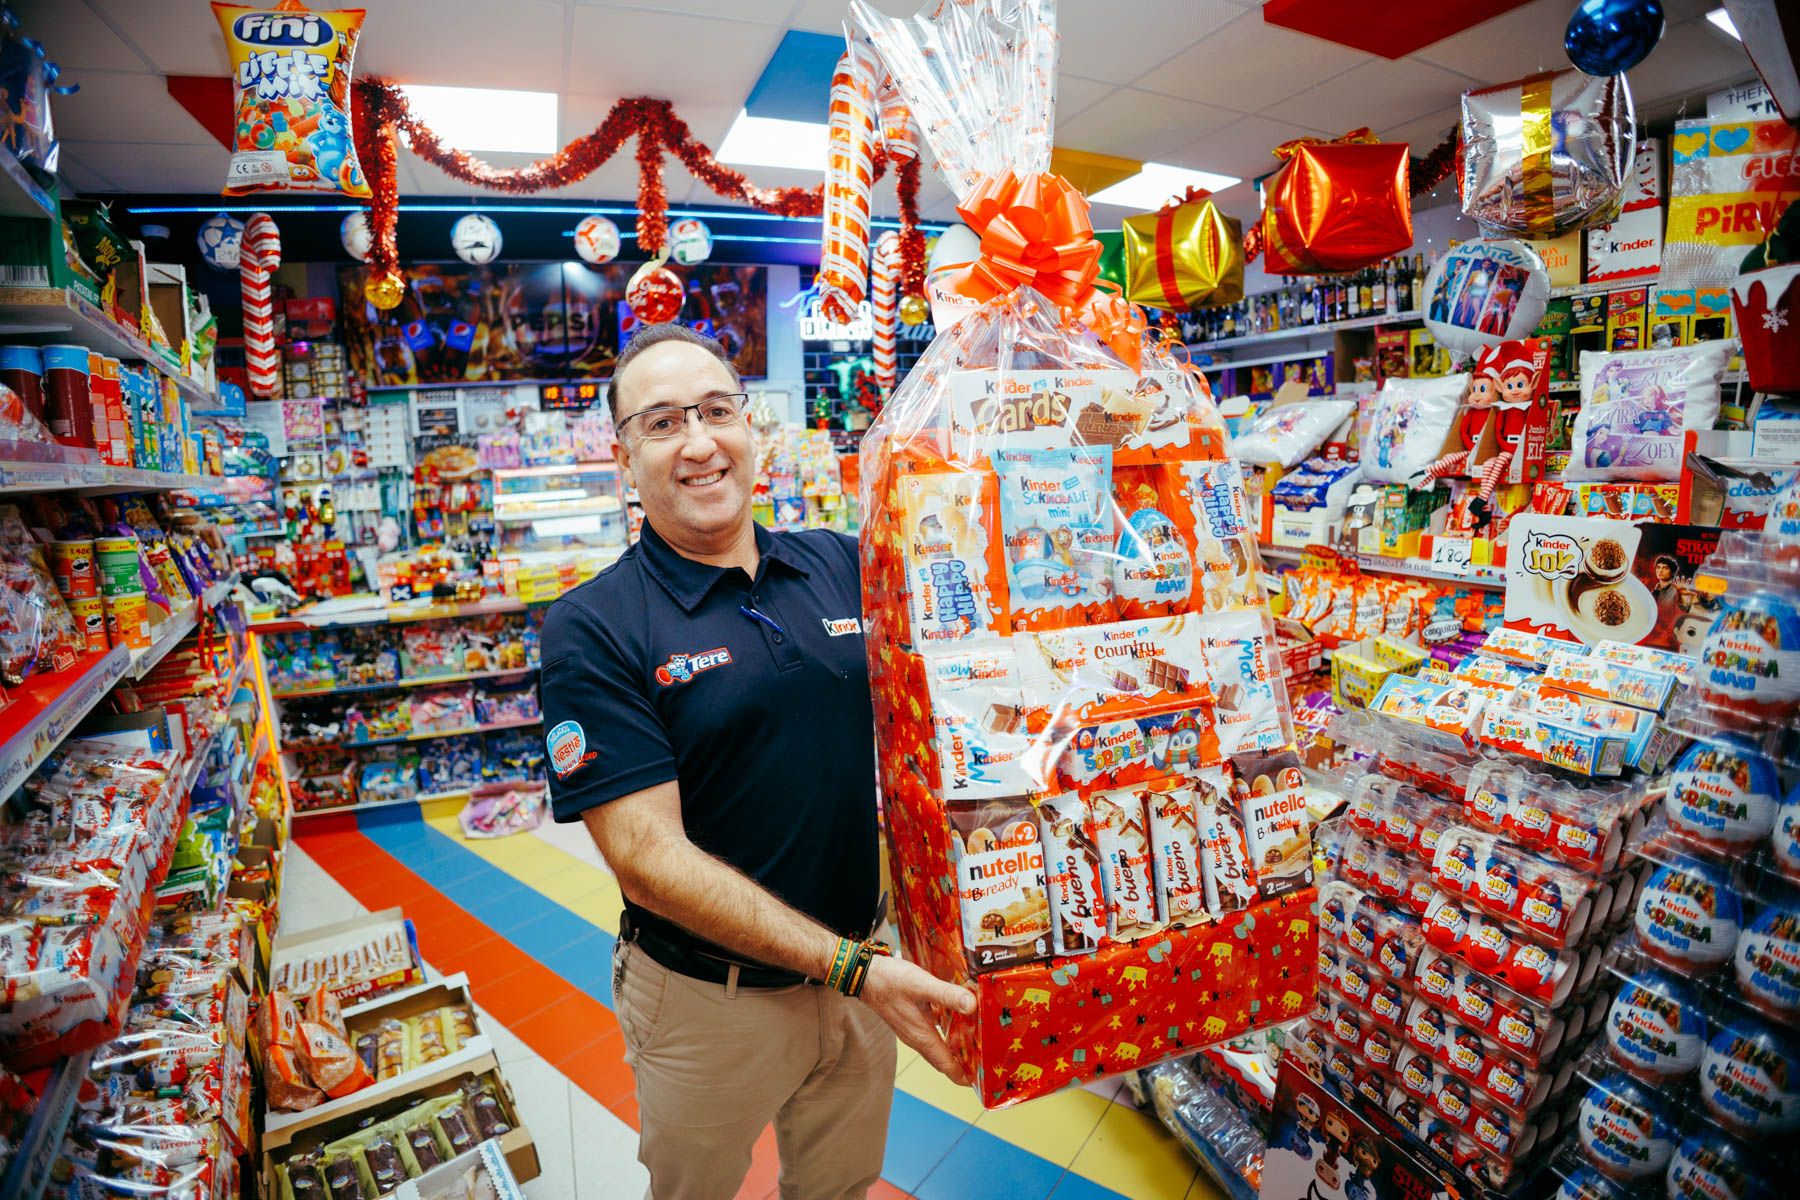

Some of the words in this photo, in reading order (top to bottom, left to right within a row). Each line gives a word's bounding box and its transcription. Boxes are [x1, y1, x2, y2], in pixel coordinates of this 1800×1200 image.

[242, 16, 320, 42] Fini
[976, 390, 1066, 436] Cards
[1527, 443, 1544, 460] Elf
[1635, 442, 1677, 465] ZOEY
[1021, 476, 1061, 492] Kinder
[1048, 507, 1070, 519] mini
[1535, 537, 1571, 550] Kinder
[1414, 563, 1431, 572] ELEGI
[1530, 550, 1575, 573] JOY
[1155, 578, 1186, 593] MAXI
[1103, 629, 1136, 642] Kinder
[1093, 639, 1155, 660] Country
[689, 650, 729, 671] Tere
[1702, 648, 1779, 679] SORPRESA
[1099, 727, 1138, 748] Kinder
[1488, 721, 1531, 740] SORPRESA
[1674, 783, 1747, 821] SORPRESA
[1216, 822, 1241, 879] bueno
[970, 851, 1043, 881] nutella
[1172, 841, 1192, 895] bueno
[1066, 855, 1086, 918] bueno
[1266, 882, 1276, 895] 2
[1643, 900, 1712, 943] SORPRESA
[982, 950, 994, 965] 2
[1415, 1151, 1437, 1171] Funko
